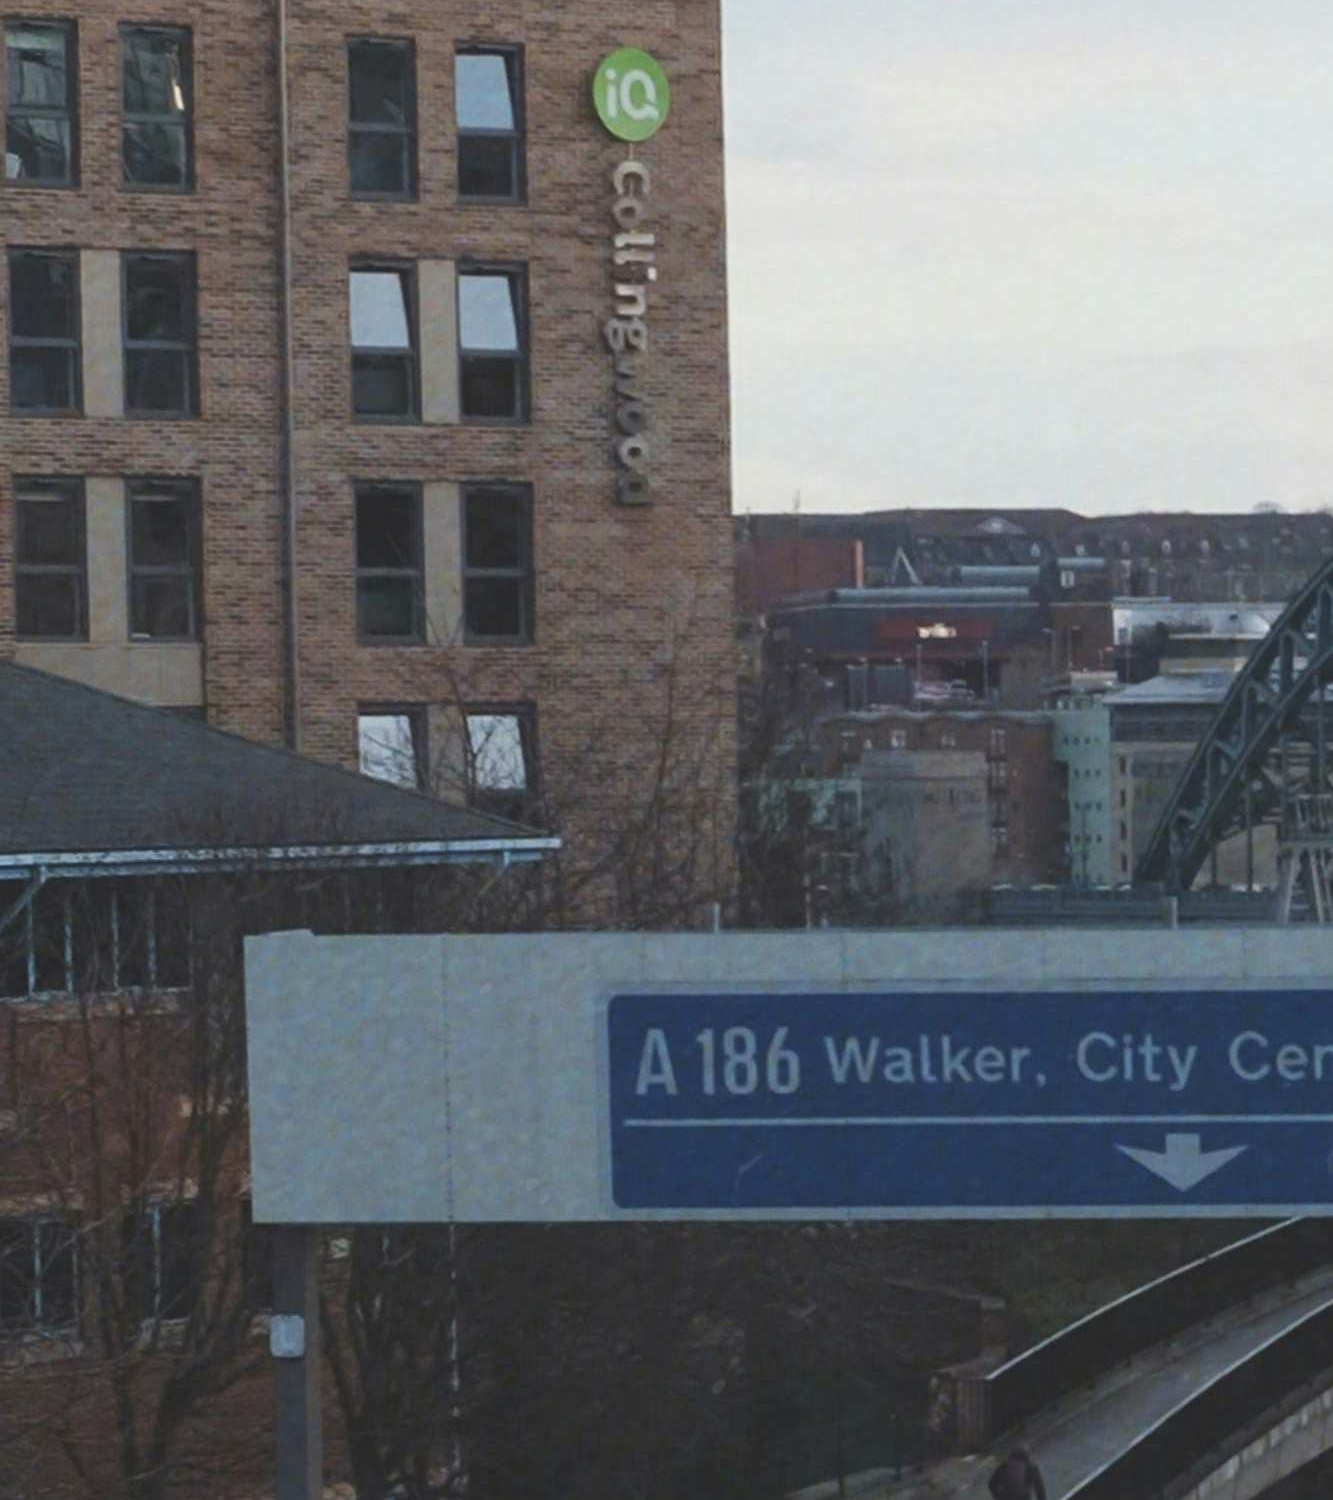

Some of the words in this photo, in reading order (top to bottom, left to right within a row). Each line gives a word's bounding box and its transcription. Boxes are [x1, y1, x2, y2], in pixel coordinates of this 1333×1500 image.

[604, 67, 660, 122] iQ
[824, 1035, 1046, 1086] Walker,
[1077, 1030, 1197, 1092] City
